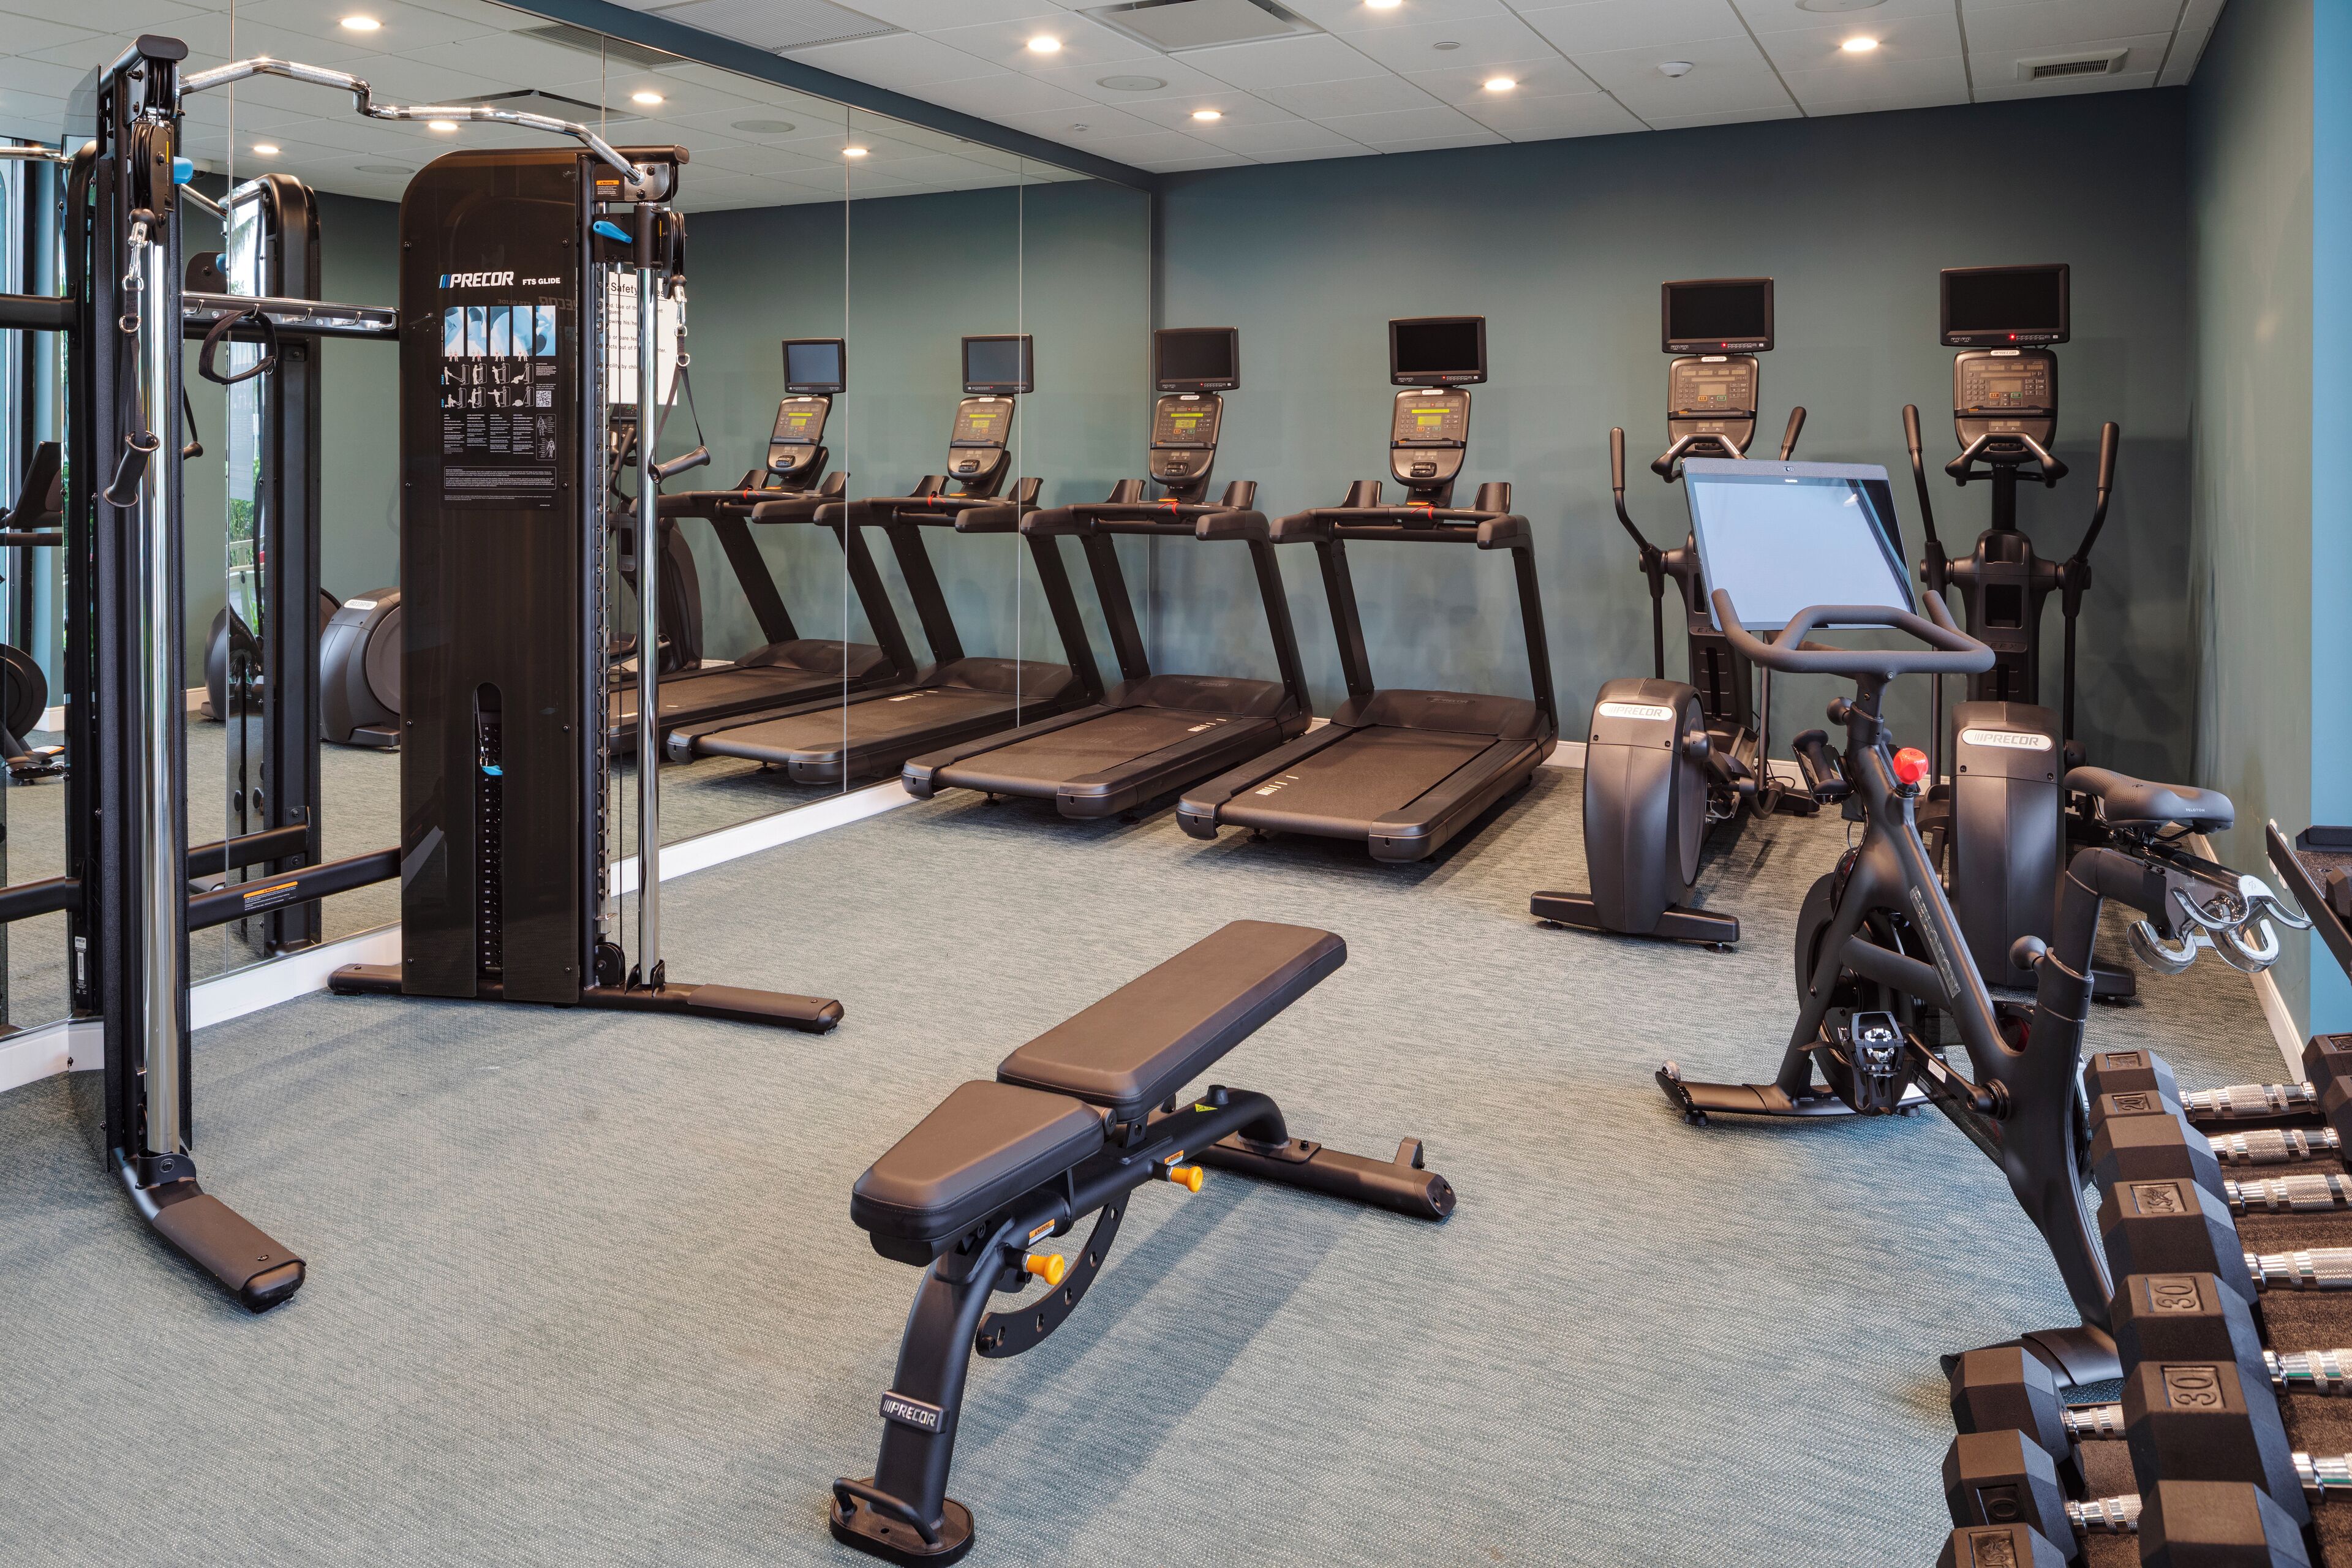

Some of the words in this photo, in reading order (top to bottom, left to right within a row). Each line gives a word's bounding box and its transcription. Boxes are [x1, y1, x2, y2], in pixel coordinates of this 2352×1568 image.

[450, 271, 514, 288] PRECOR
[611, 282, 637, 296] Safety
[1616, 706, 1662, 717] PRECOR
[1984, 734, 2039, 746] PRECOR
[1913, 888, 1960, 990] PELOTON
[2120, 1097, 2144, 1111] 20
[2154, 1285, 2196, 1309] 30
[2170, 1377, 2217, 1406] 30
[890, 1401, 937, 1427] PRECOR
